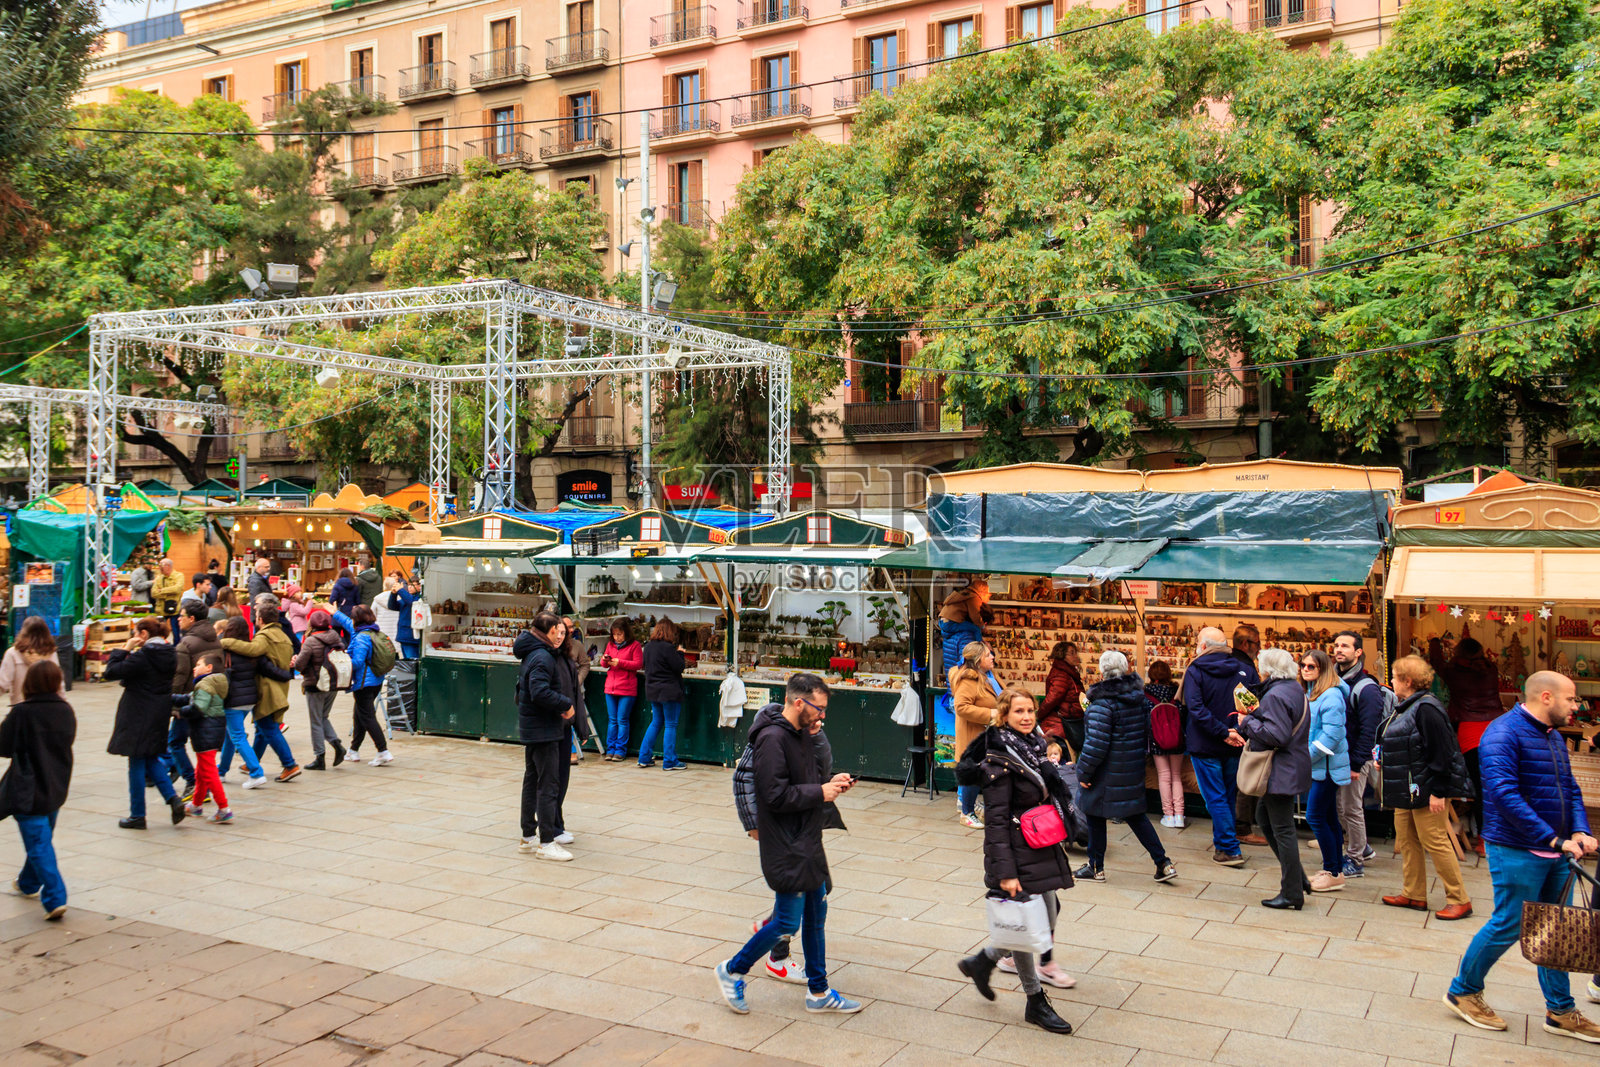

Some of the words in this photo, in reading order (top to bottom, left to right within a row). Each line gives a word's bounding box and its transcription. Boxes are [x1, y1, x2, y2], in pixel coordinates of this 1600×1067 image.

[572, 481, 598, 491] smile
[681, 487, 703, 497] SUN
[1445, 511, 1460, 522] 97
[711, 532, 724, 544] 102
[889, 531, 903, 543] 101
